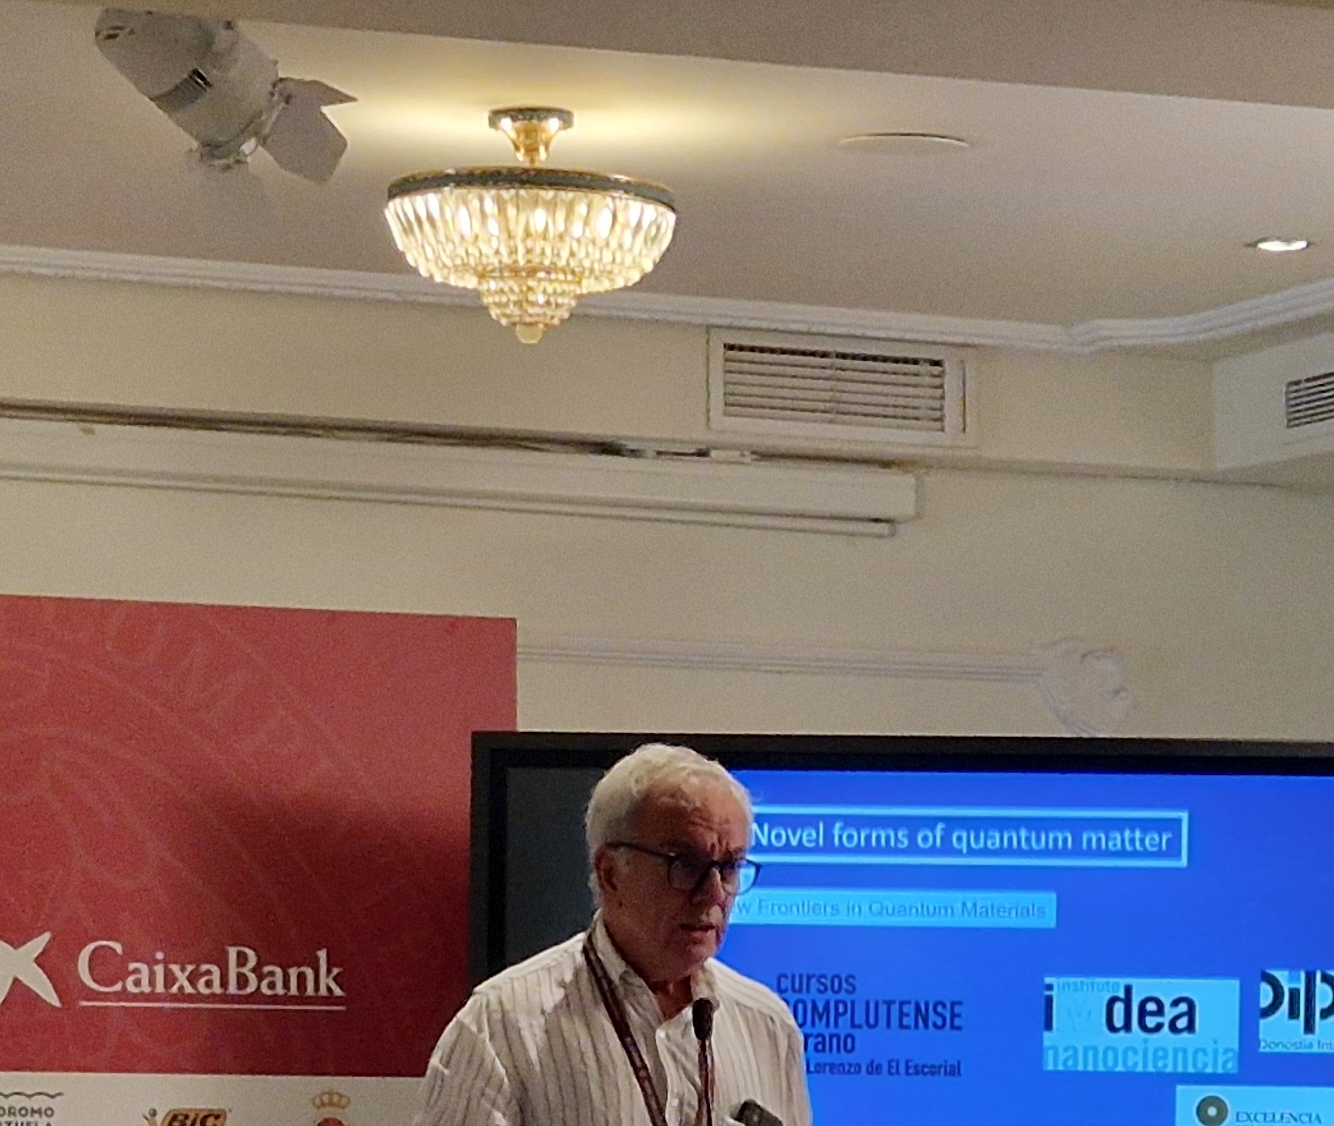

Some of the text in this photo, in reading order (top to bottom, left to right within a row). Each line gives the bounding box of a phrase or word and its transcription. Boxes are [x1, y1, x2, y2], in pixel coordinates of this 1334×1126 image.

[752, 821, 1172, 854] Novel forms of quantum matter
[757, 897, 839, 916] Frontiers
[847, 899, 862, 917] in
[869, 900, 955, 918] Quantum
[961, 901, 1047, 919] Materials
[77, 940, 346, 997] CaixaBank
[776, 972, 857, 995] cursos
[804, 1031, 856, 1054] rano
[1044, 1039, 1238, 1073] nanociencia
[806, 1059, 962, 1077] Lorenzo de El Escorial
[1235, 1111, 1322, 1124] EXCELENCIA
